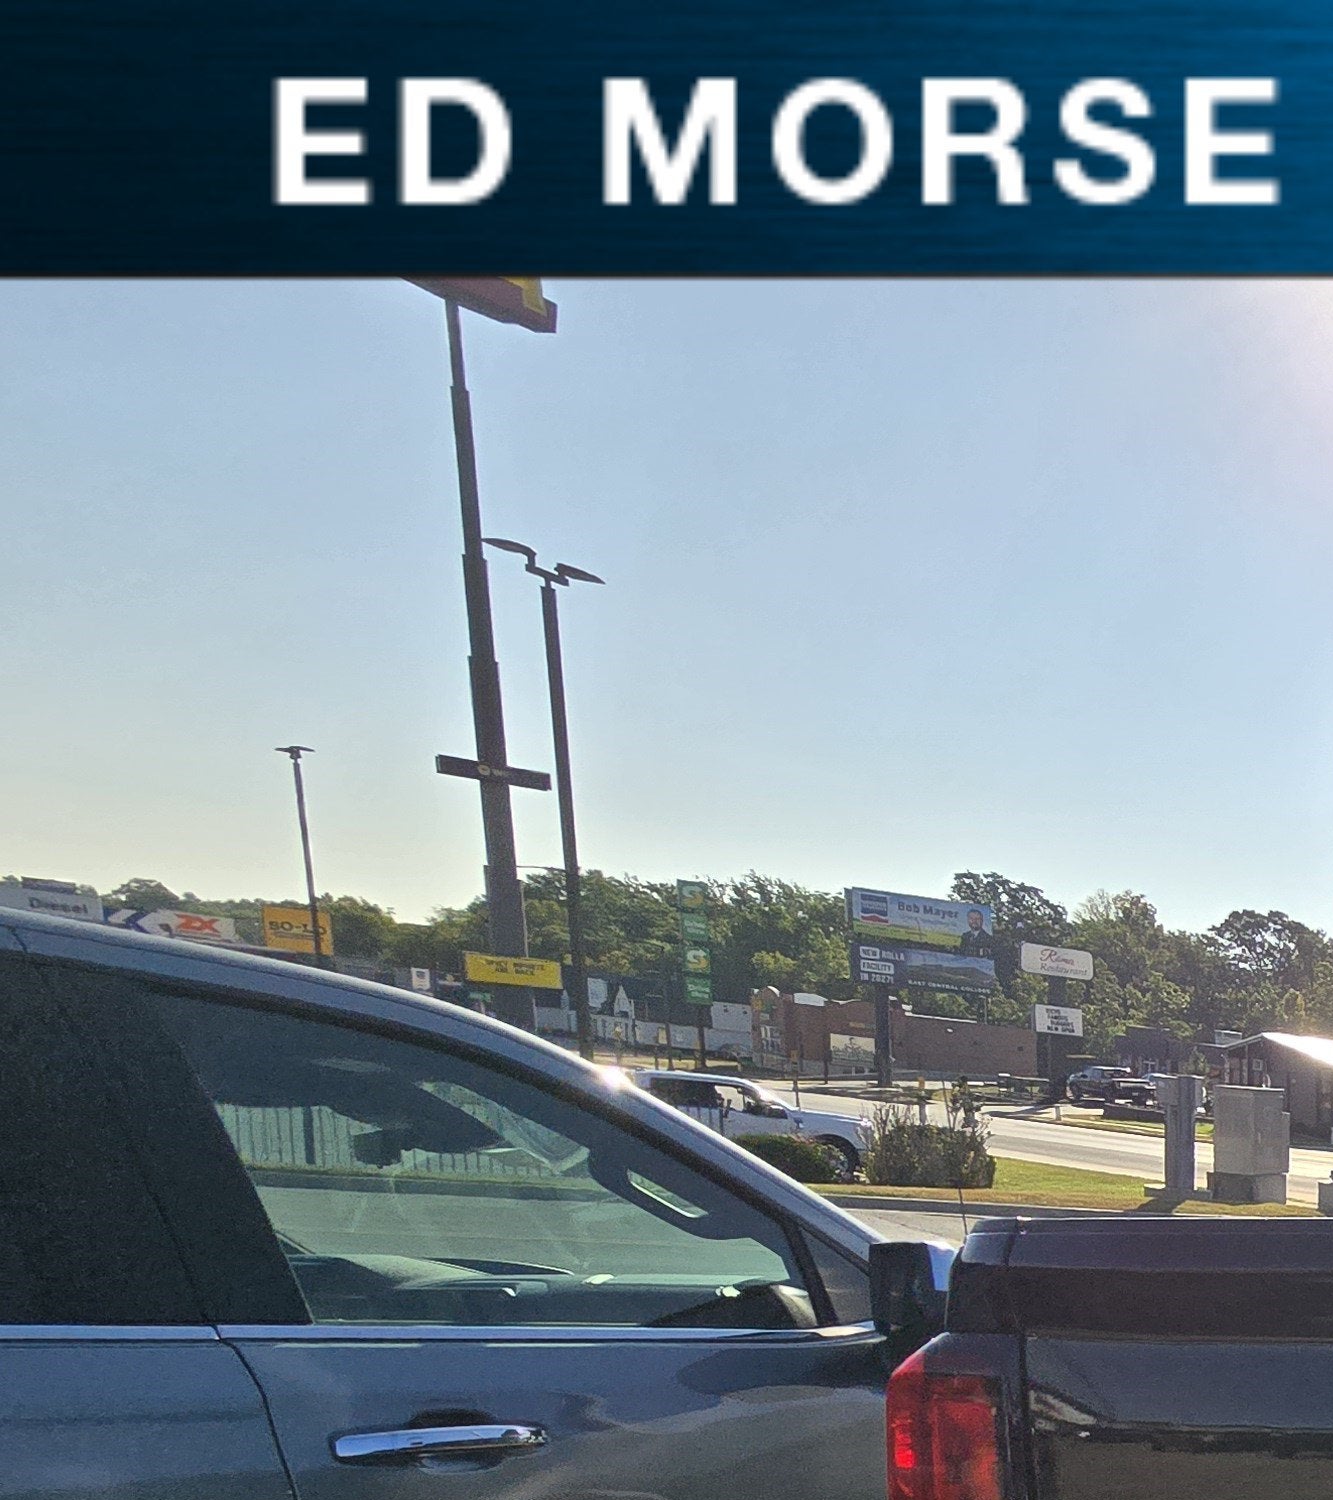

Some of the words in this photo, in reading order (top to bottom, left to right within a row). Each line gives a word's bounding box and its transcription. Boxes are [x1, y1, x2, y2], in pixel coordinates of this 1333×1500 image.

[898, 902, 920, 914] Bob
[922, 904, 960, 919] Mayer
[882, 950, 905, 961] ROLLA
